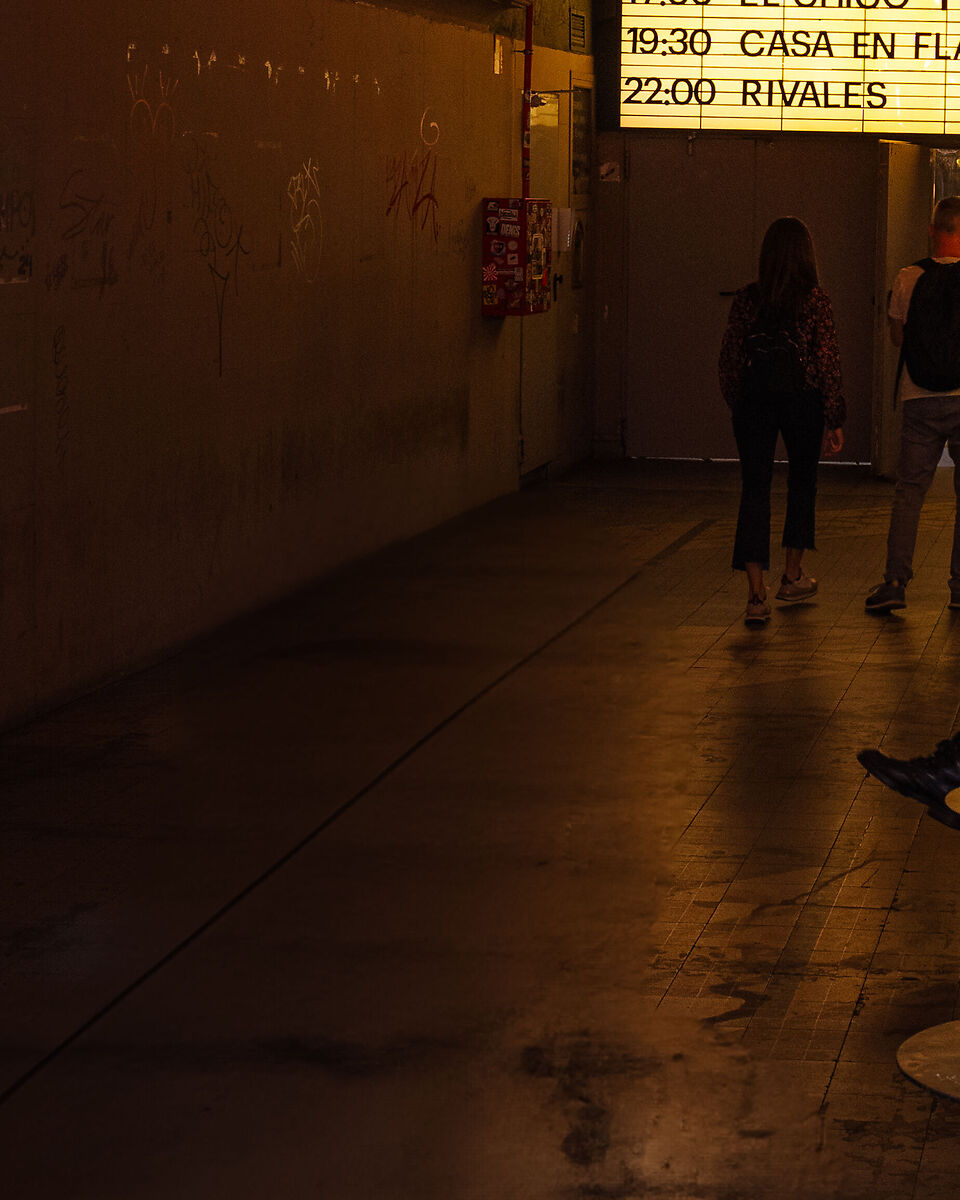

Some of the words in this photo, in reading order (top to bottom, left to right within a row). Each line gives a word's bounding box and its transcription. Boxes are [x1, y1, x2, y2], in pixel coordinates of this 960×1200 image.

[626, 28, 711, 56] 19:30
[740, 30, 834, 58] CASA
[853, 32, 896, 59] EN
[622, 77, 716, 106] 22:00
[742, 80, 887, 108] RIVALES
